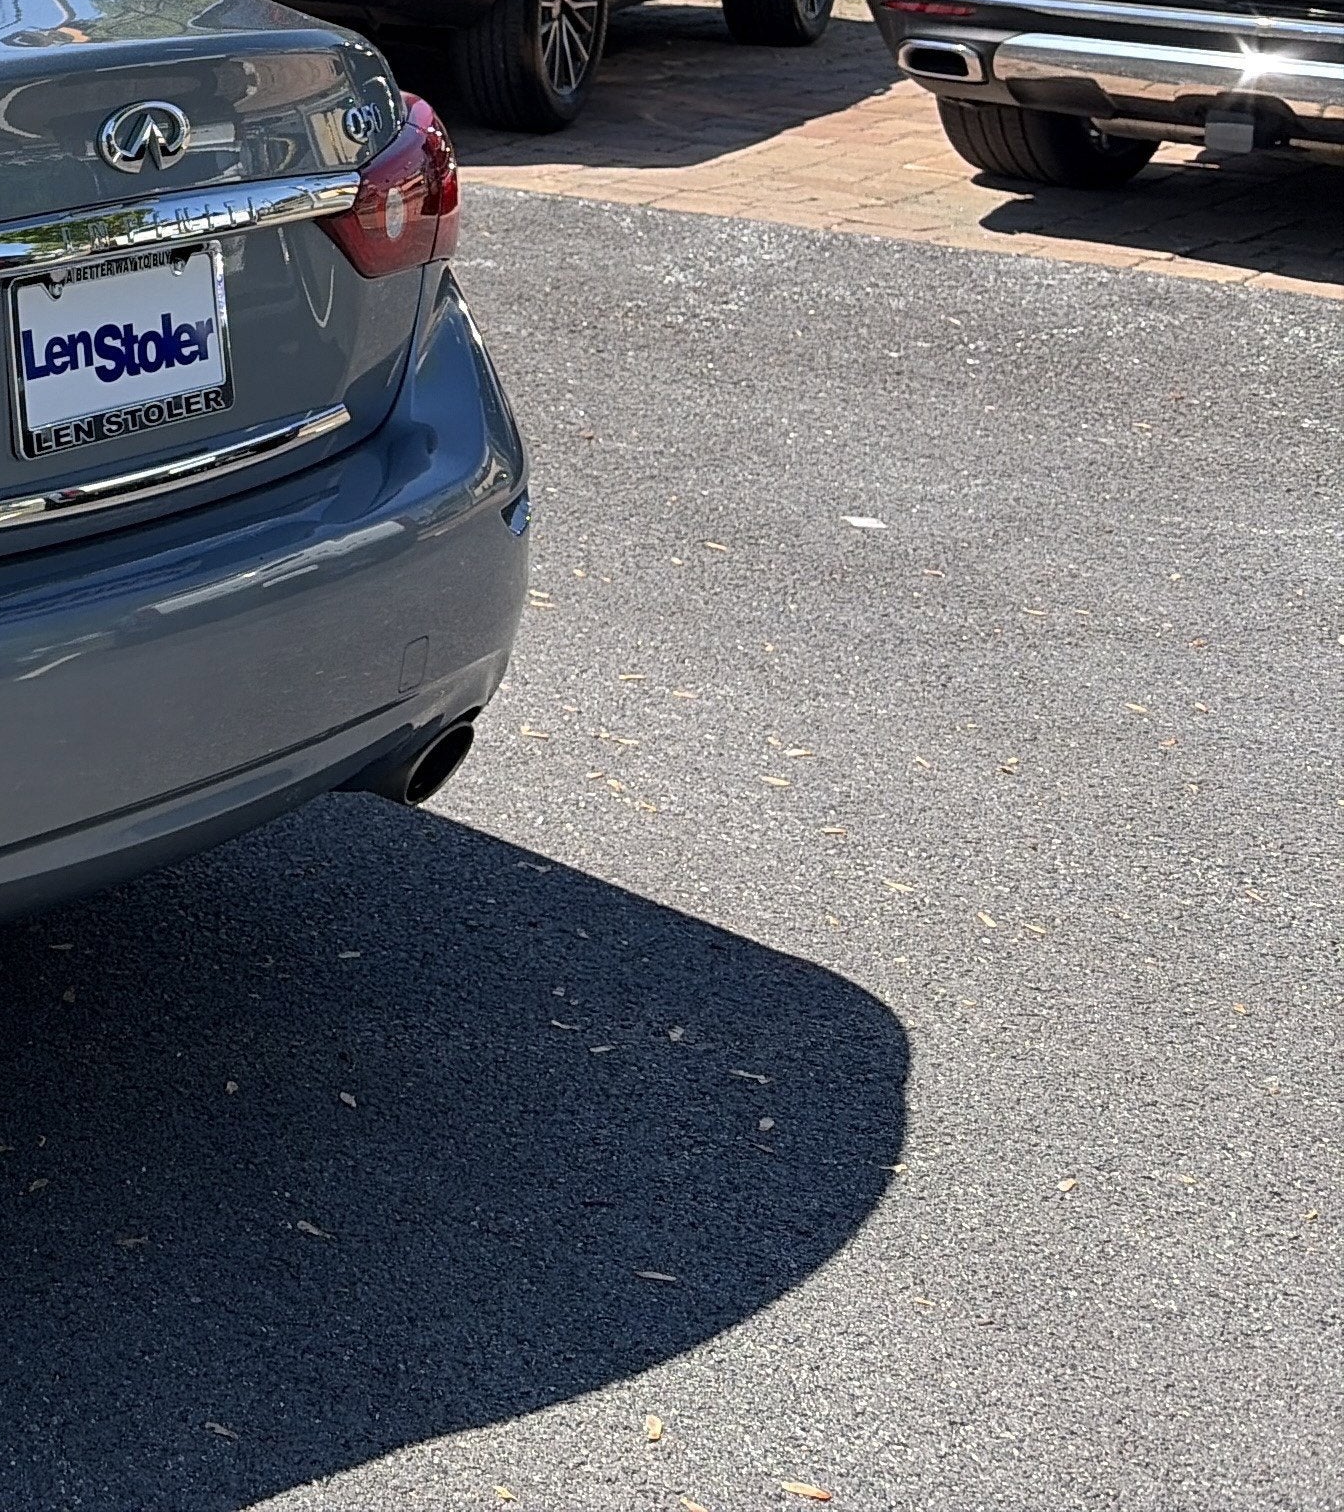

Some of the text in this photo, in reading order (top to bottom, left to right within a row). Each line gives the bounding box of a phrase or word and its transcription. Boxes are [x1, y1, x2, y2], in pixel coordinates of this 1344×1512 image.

[65, 251, 173, 284] A BETTER WAY TO BUY
[32, 388, 226, 456] LEN STOLER
